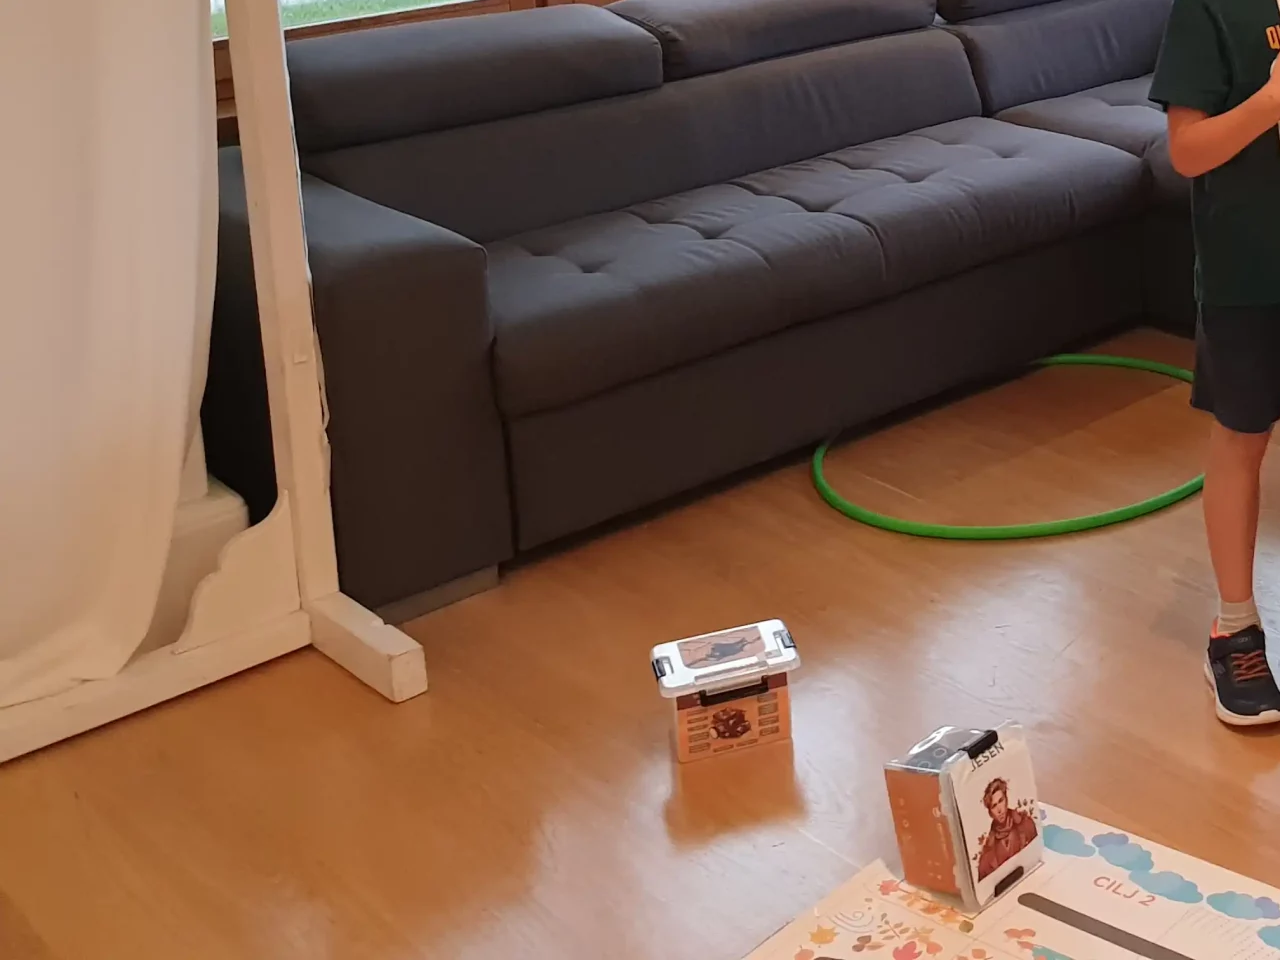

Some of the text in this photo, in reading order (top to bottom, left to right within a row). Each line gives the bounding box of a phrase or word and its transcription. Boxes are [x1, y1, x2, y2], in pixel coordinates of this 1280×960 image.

[971, 741, 1005, 772] JESEN
[1093, 876, 1156, 907] CILJ 2
